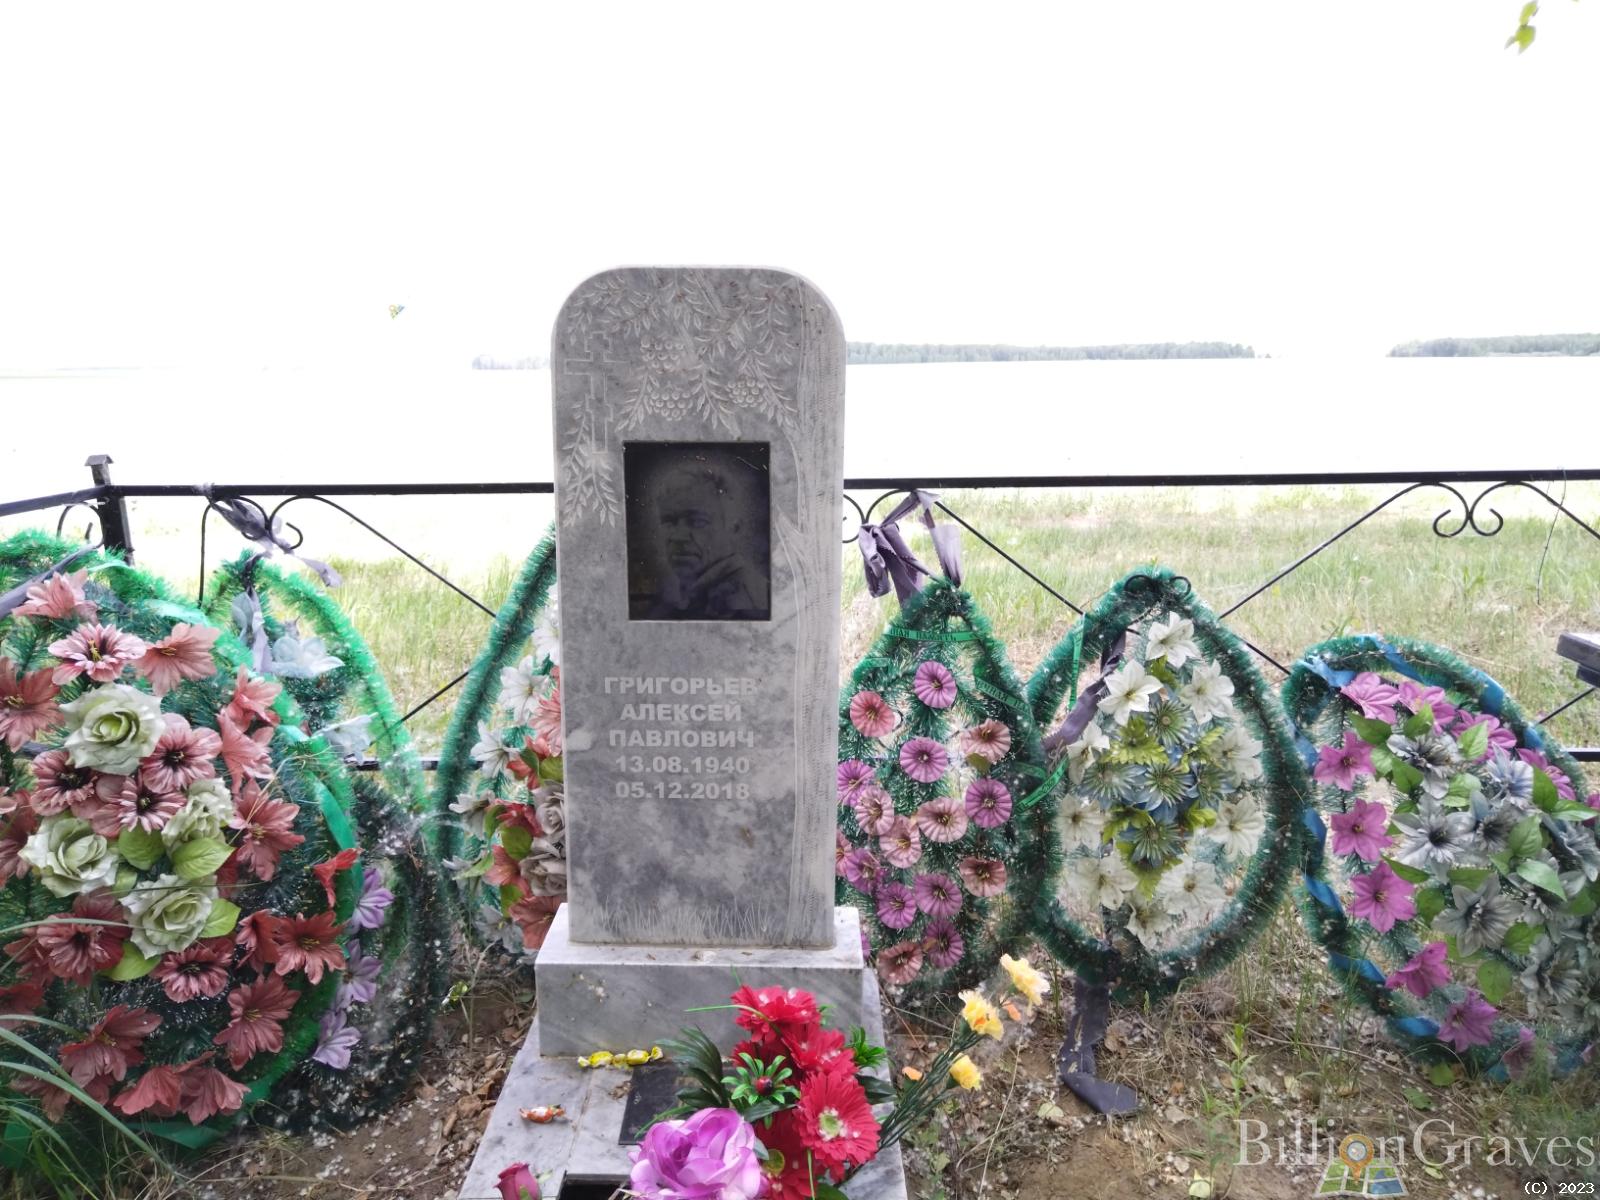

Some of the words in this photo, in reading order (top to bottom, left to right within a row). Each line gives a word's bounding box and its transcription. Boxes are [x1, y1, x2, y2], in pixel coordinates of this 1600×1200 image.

[604, 676, 758, 695] ГРИГОРЬЕВ
[620, 700, 742, 722] АЛЕКСЕЙ
[609, 729, 754, 748] ПАВЛОВИЧ
[615, 755, 750, 774] 13.08.1940
[615, 781, 750, 800] 05.12.2018
